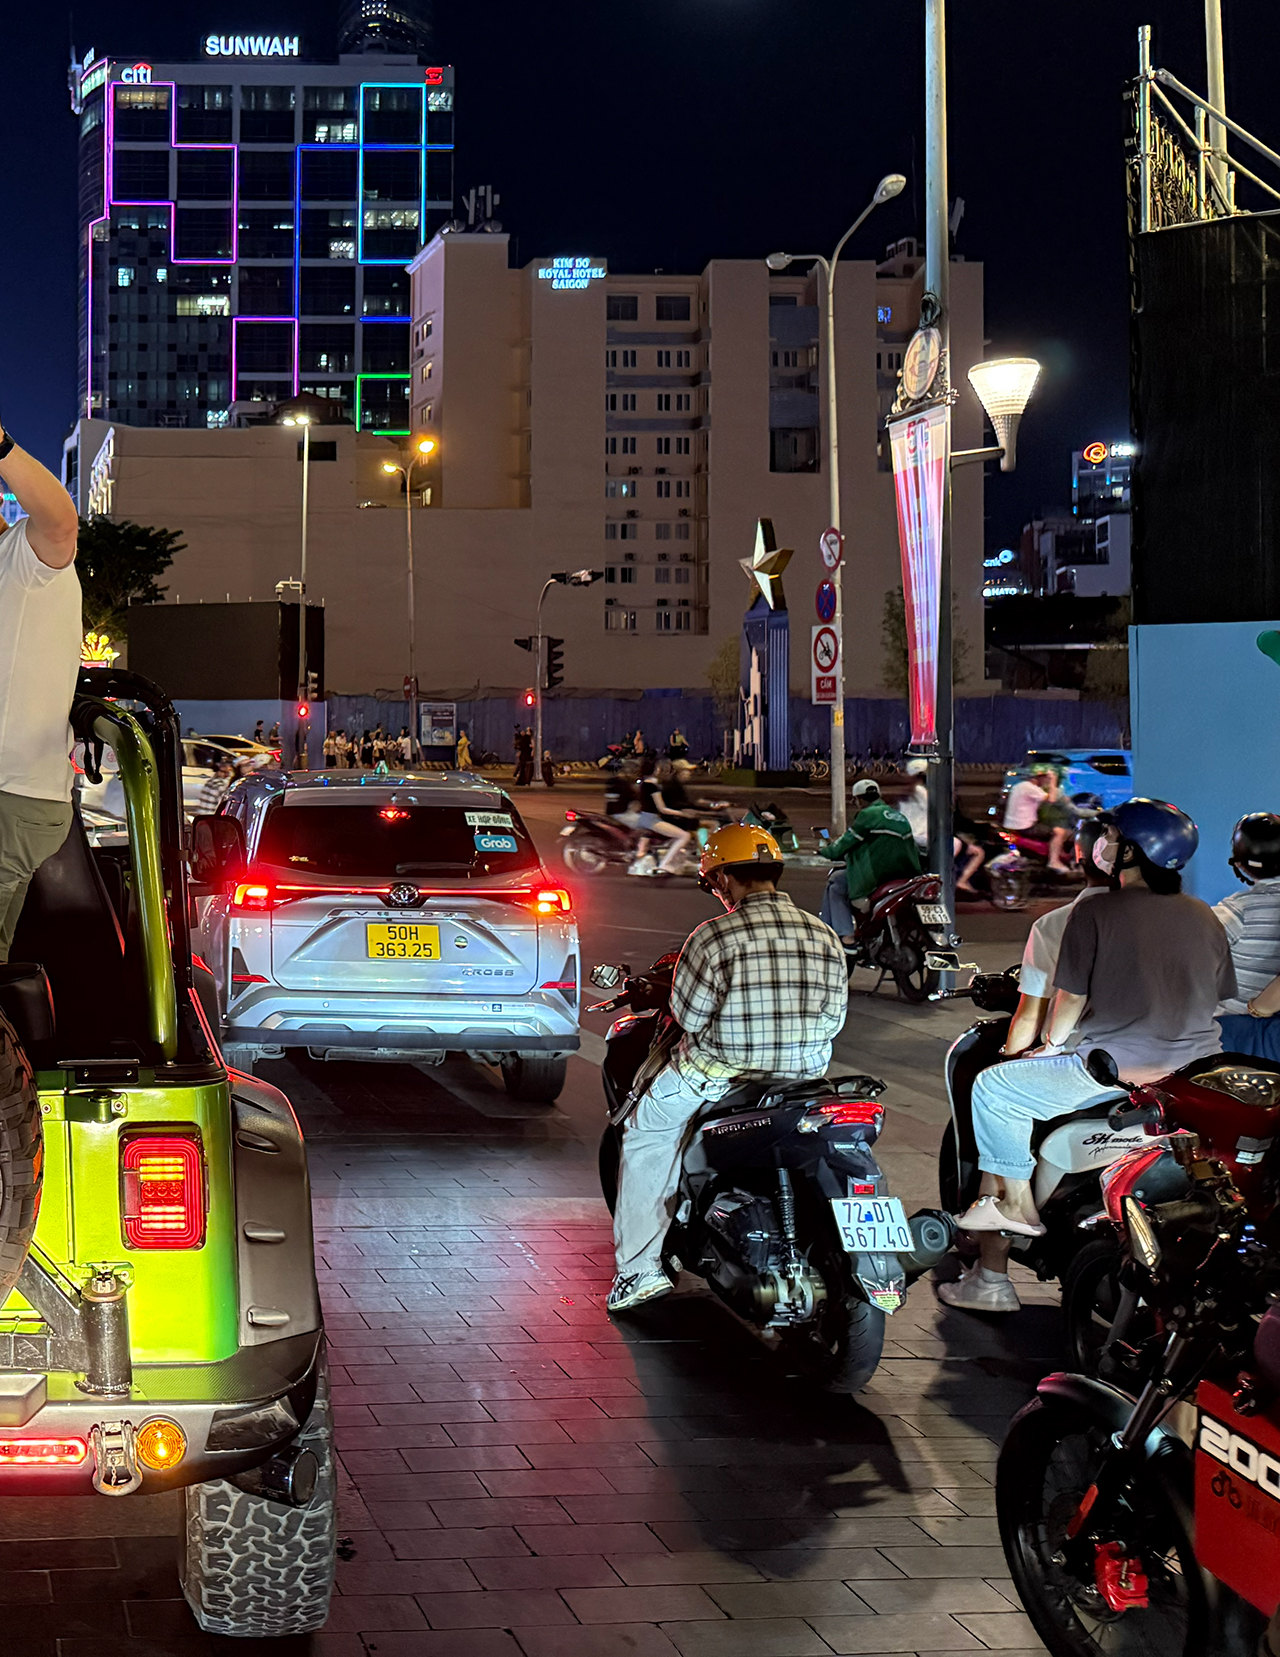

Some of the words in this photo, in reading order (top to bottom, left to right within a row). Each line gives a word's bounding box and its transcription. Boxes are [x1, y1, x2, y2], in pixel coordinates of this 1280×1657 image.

[205, 35, 299, 57] SUNWAH
[553, 258, 574, 269] KIM
[575, 258, 590, 269] DO
[538, 268, 572, 279] ROYAL
[572, 268, 607, 279] HOTEL
[552, 279, 589, 289] SAIGON
[480, 838, 512, 849] Grab
[387, 926, 419, 941] 50H
[375, 942, 433, 958] 363.25
[1082, 1132, 1115, 1145] SH
[842, 1226, 910, 1248] 567.40
